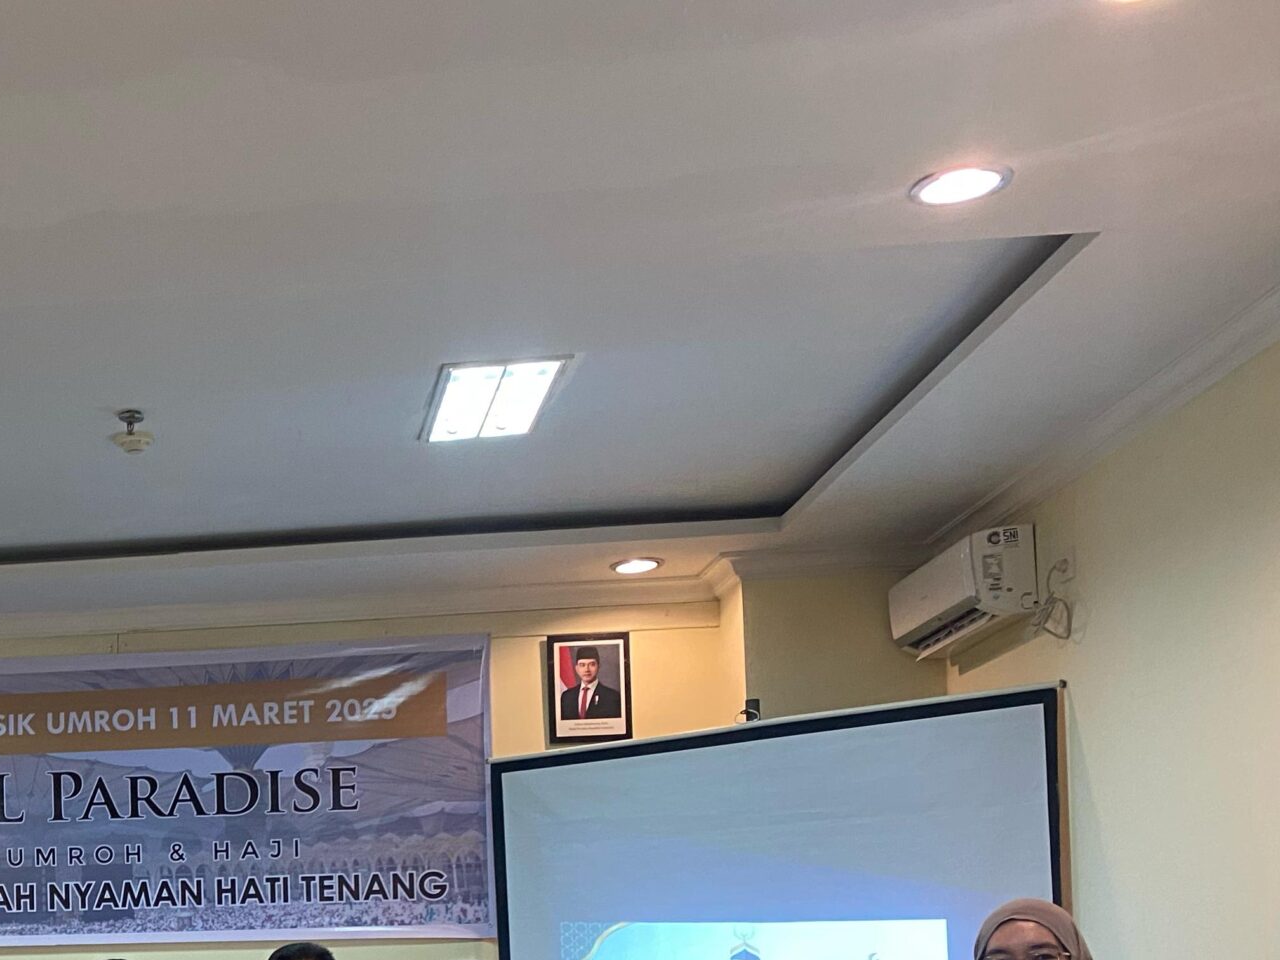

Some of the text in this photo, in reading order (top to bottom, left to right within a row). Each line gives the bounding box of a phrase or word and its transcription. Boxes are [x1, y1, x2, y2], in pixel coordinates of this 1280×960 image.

[1002, 529, 1019, 541] SNI
[46, 707, 156, 735] UMROH
[169, 705, 197, 730] 11
[212, 700, 315, 728] MARET
[327, 698, 398, 724] 2025
[45, 765, 360, 823] PARADISE
[6, 839, 300, 869] UMROH & HAJI
[47, 878, 204, 912] NYAMAN
[219, 876, 289, 907] HATI
[300, 869, 449, 905] TENANG
